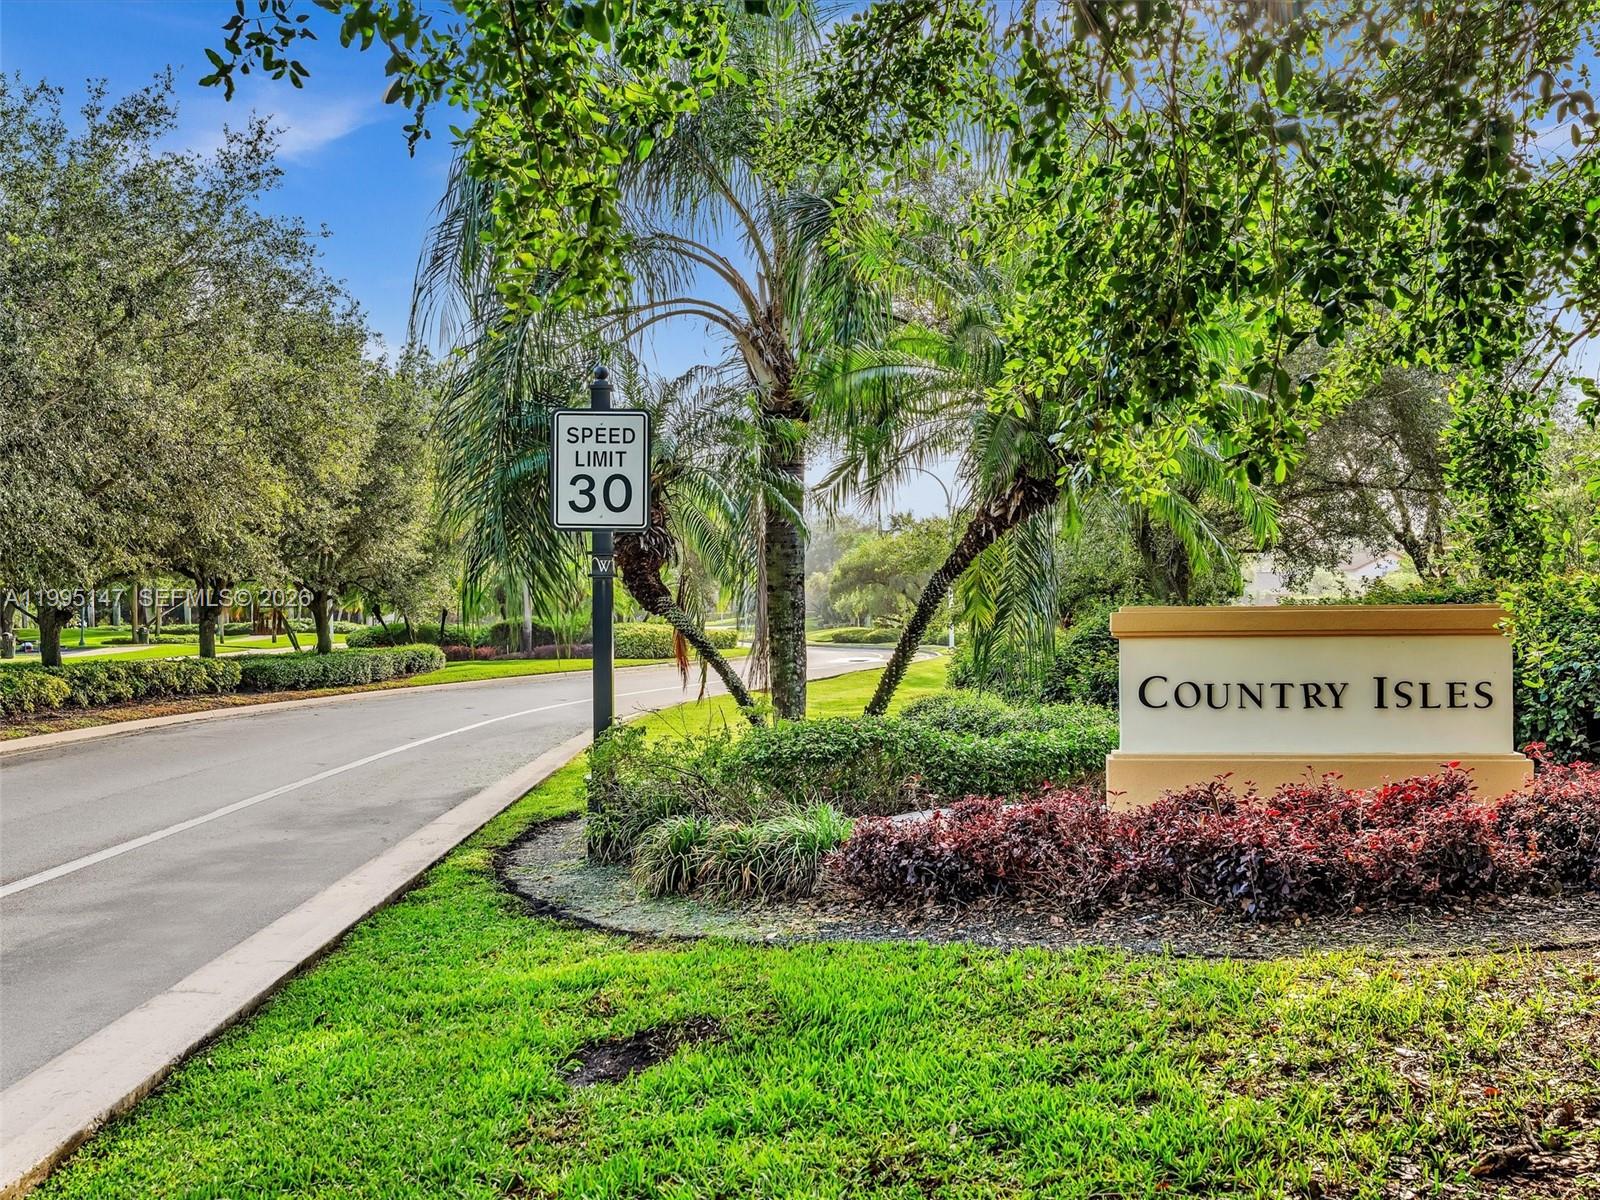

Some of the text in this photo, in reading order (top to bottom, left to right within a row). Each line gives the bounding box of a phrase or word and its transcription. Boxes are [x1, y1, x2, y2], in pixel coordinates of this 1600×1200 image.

[566, 427, 635, 444] SPEED
[575, 451, 627, 467] LIMIT
[568, 474, 632, 513] 30
[1138, 675, 1494, 710] COUNTRY ISLES
